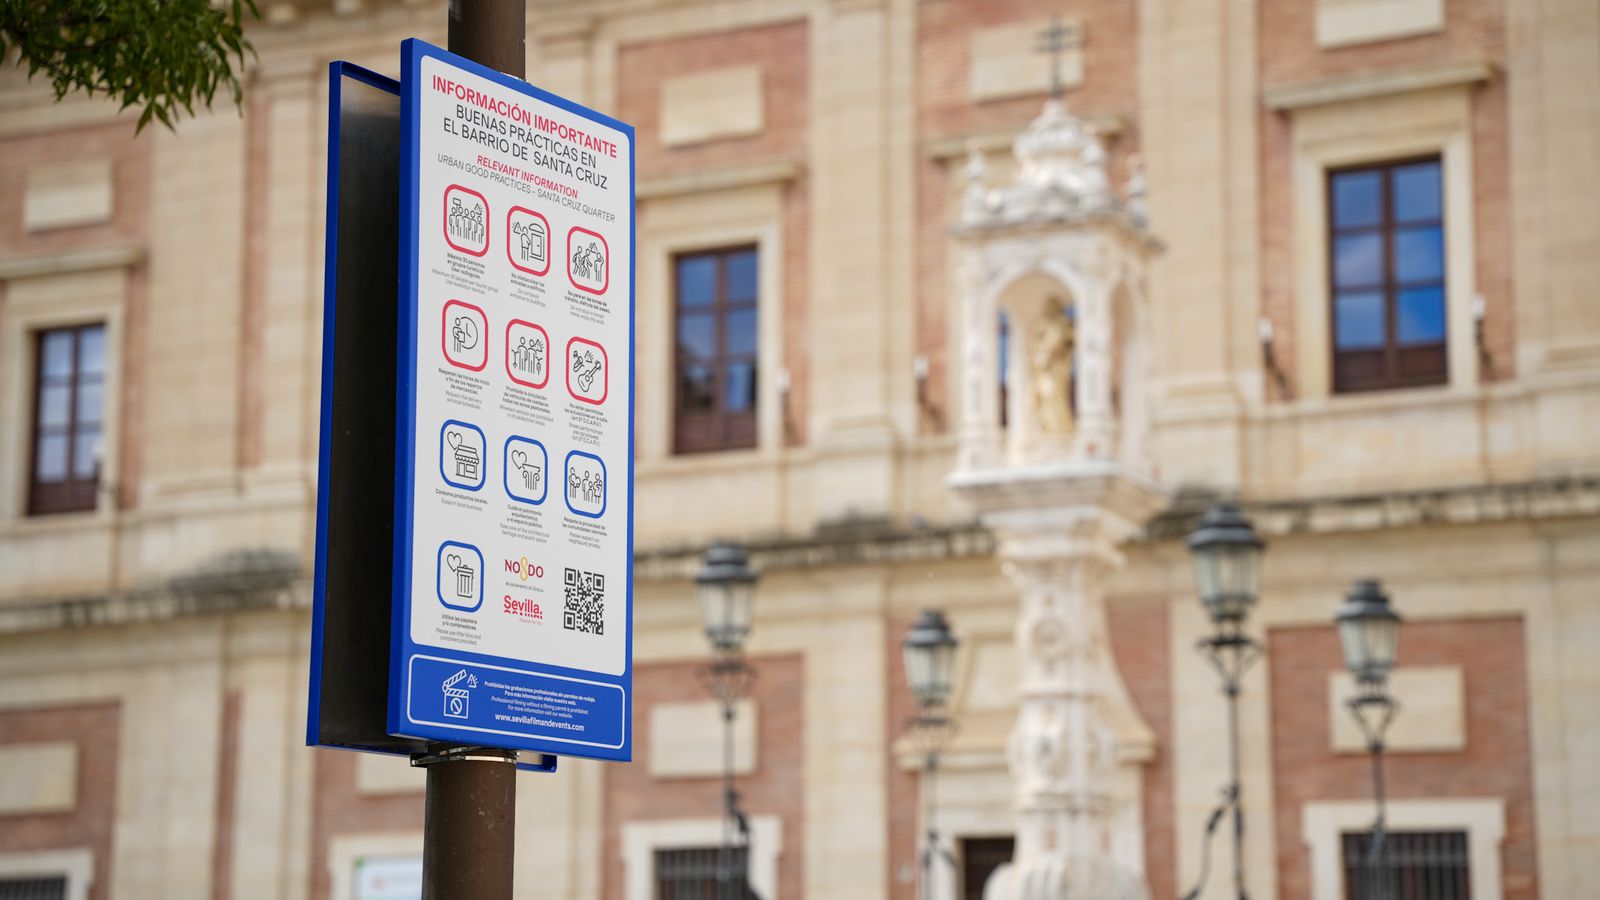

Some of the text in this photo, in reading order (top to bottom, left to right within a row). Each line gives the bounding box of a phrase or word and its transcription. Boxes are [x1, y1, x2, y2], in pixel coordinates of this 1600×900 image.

[433, 75, 616, 158] INFORMACIÓN IMPORTANTE
[457, 105, 596, 168] BUENAS PRÁCTICAS EN
[444, 118, 607, 189] EL BARRIO DE SANTA CRUZ
[477, 155, 578, 198] RELEVANT INFORMATION
[438, 154, 464, 170] URBAN
[465, 164, 488, 179] GOOD
[490, 172, 531, 194] PRACTICES
[537, 189, 561, 204] SANTA
[562, 197, 581, 210] CRUZ
[582, 204, 615, 223] QUARTER
[504, 595, 543, 615] Sevilla.
[494, 714, 585, 731] www.sevillafilmandevents.com
